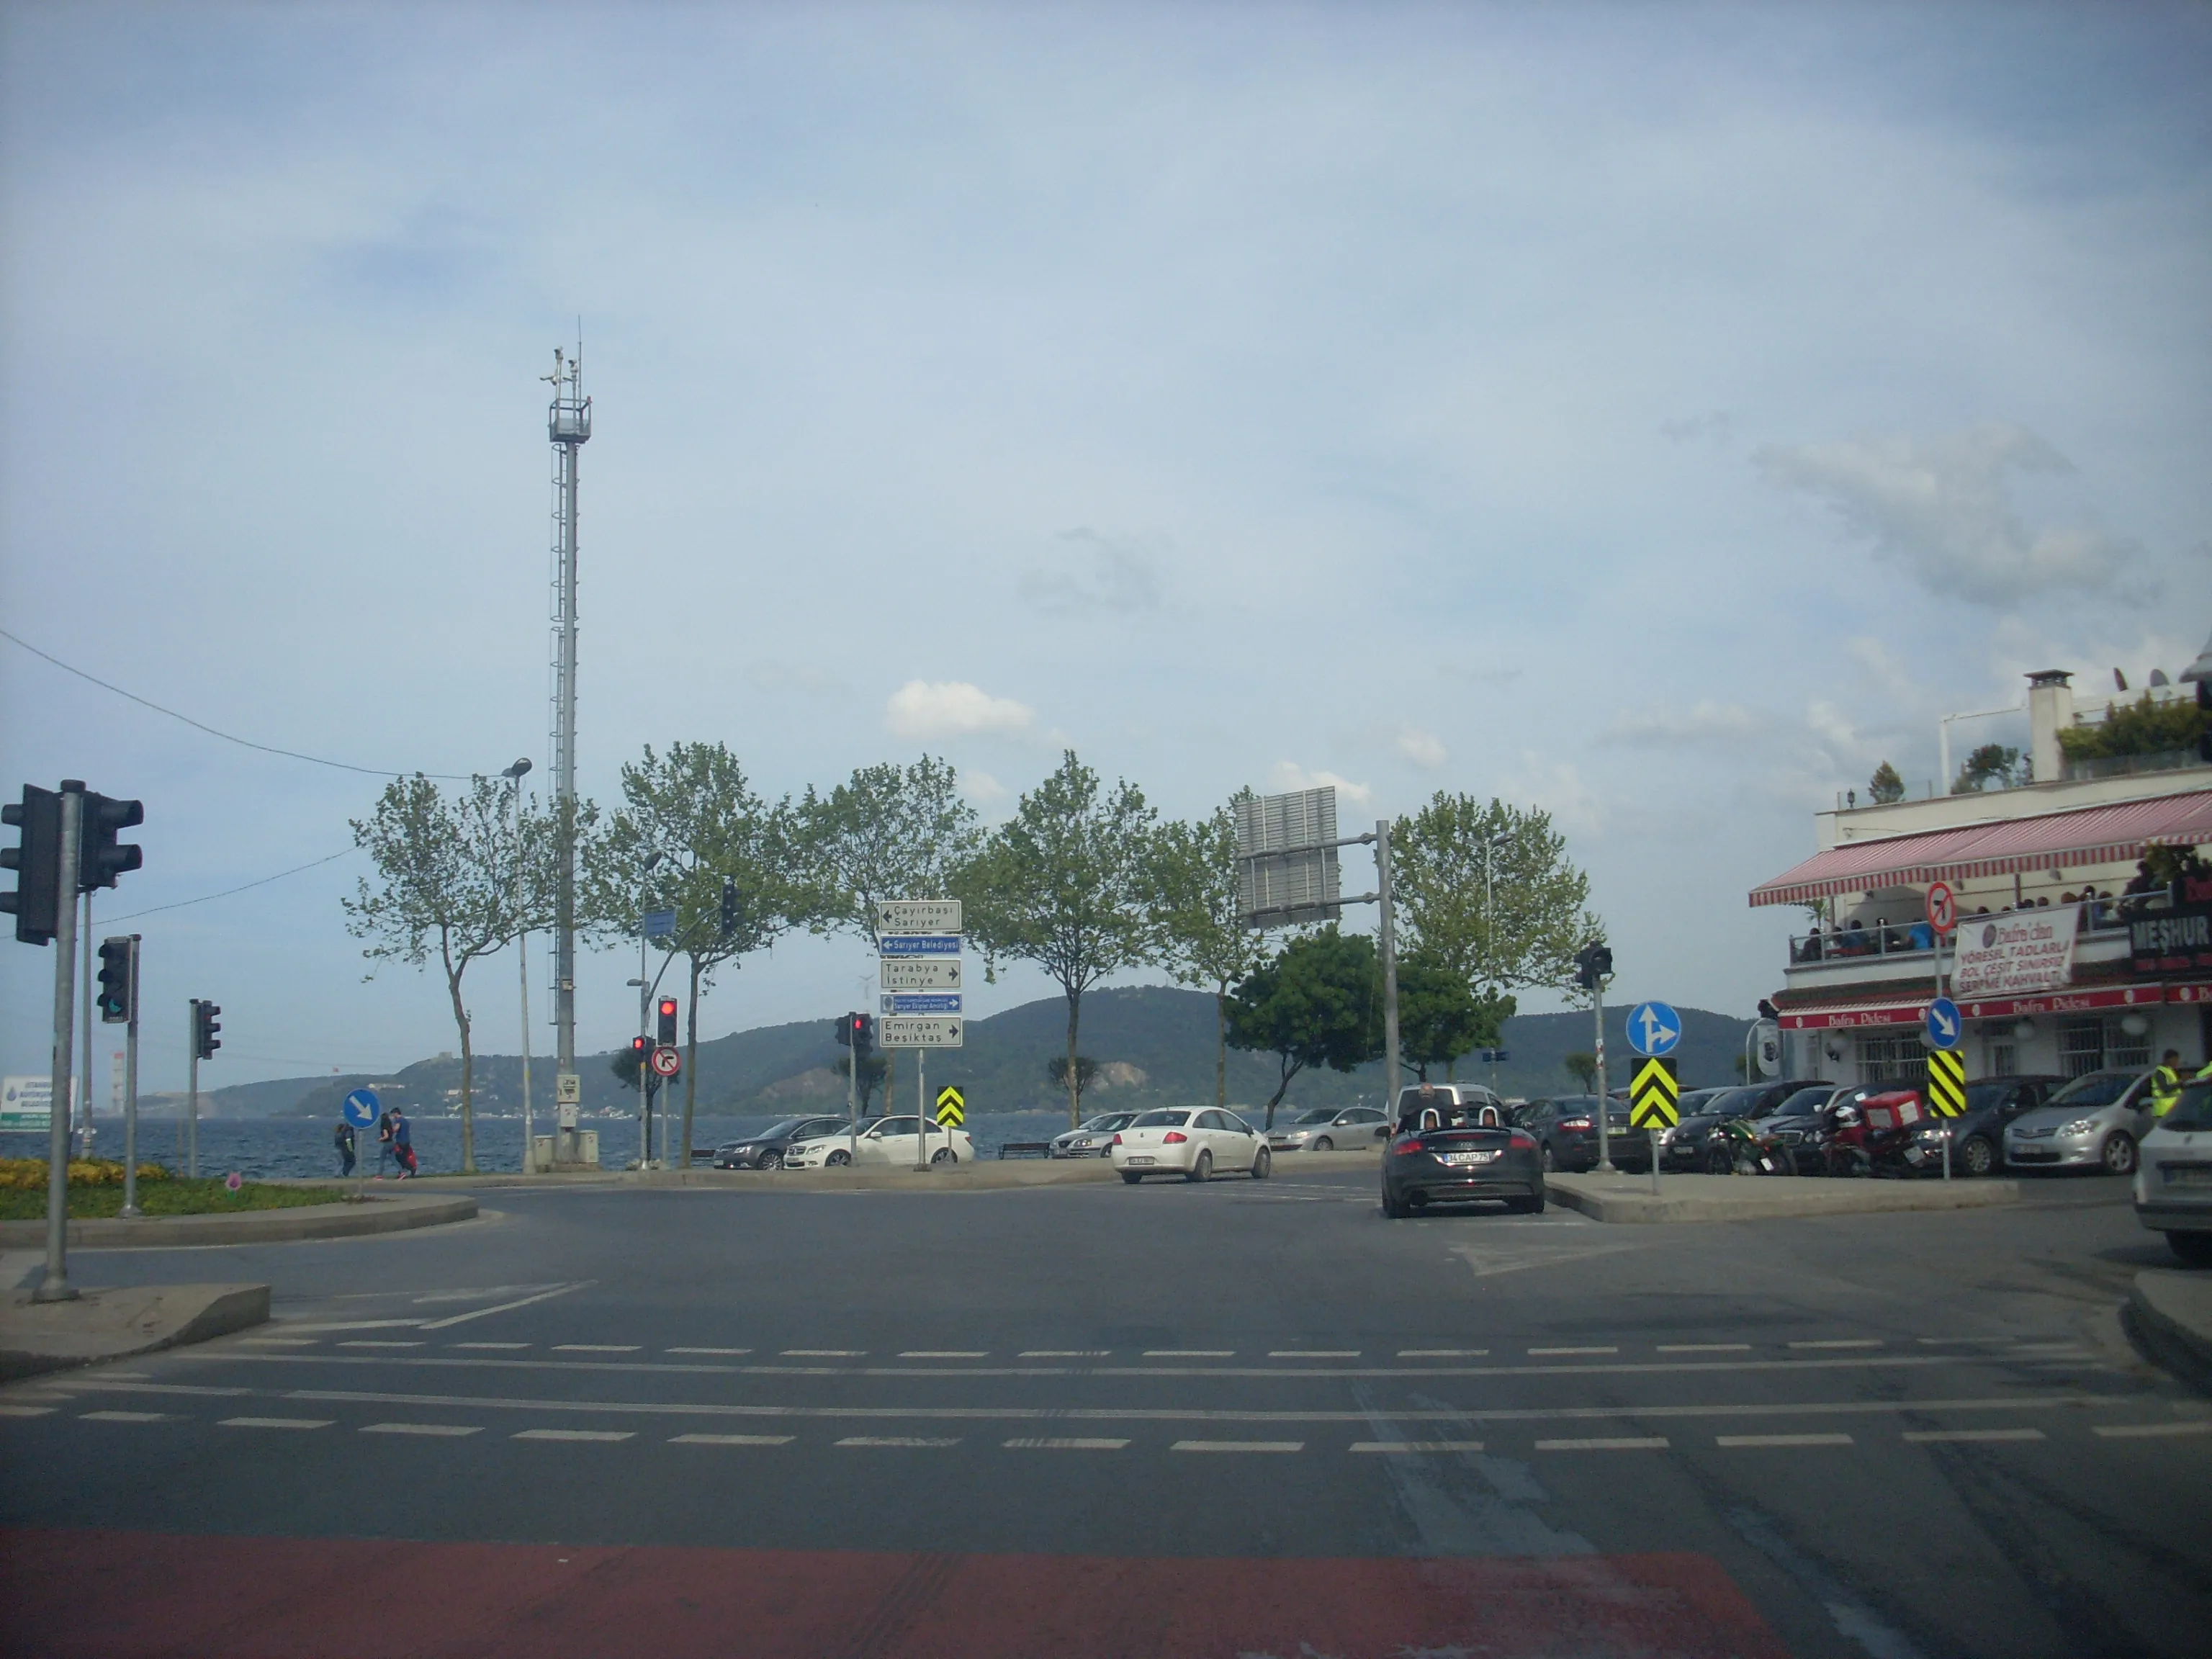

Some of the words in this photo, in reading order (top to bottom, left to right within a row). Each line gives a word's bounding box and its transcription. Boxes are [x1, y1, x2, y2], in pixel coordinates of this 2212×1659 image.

[894, 906, 953, 916] Çayırbaşı
[894, 918, 940, 927] Sarıyer
[894, 940, 920, 950] Sarıyer
[922, 940, 958, 950] Belediyesi
[886, 963, 938, 974] Tarabya
[886, 974, 933, 986] İstinye
[1829, 1014, 1854, 1026] Bafra
[885, 1021, 940, 1033] Emirgan
[885, 1033, 942, 1043] Beşiktaş
